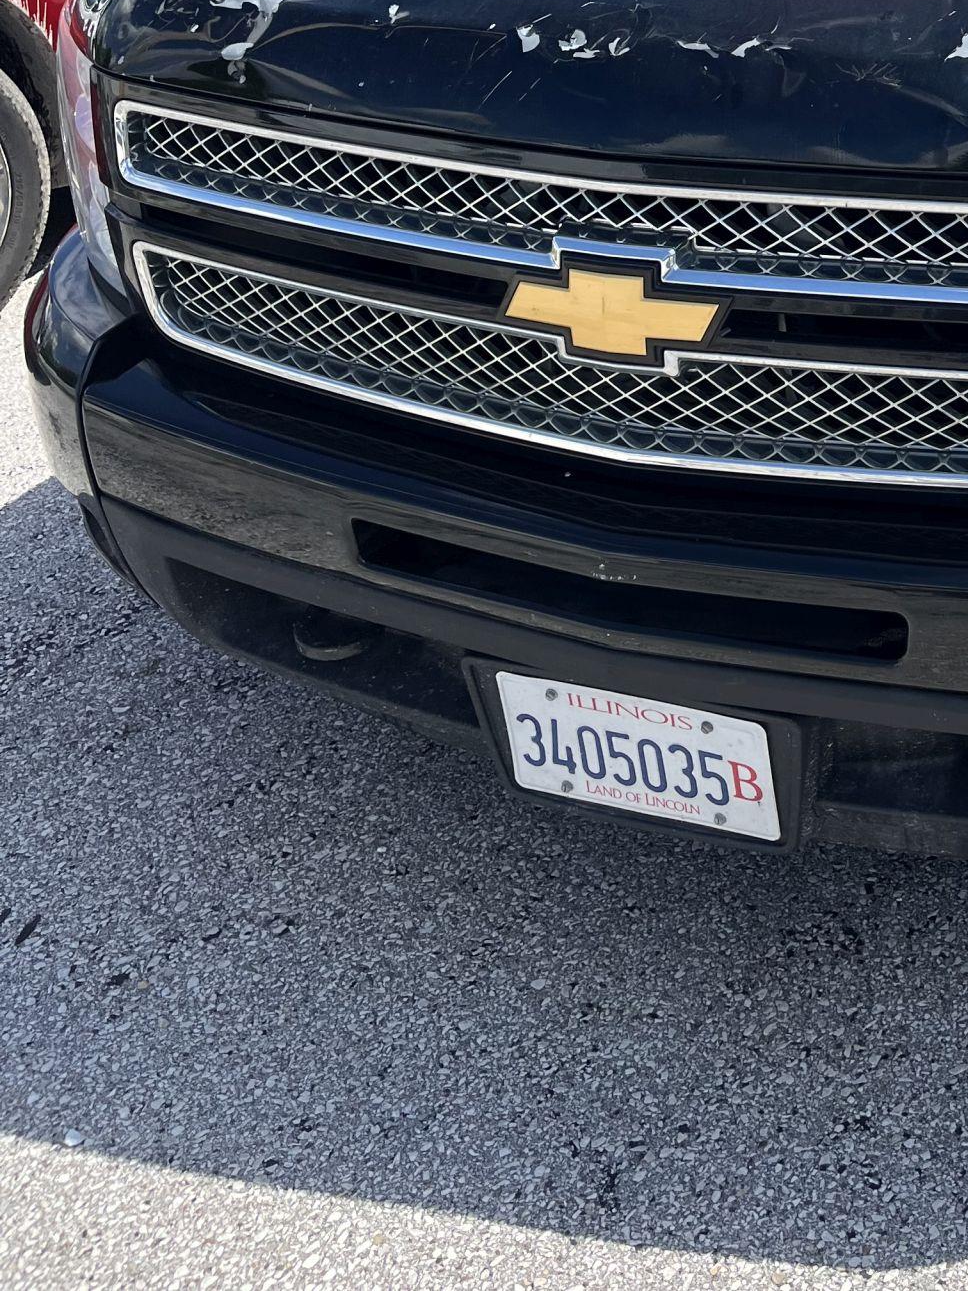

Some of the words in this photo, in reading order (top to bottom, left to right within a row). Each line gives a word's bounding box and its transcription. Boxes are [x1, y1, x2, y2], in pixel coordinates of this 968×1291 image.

[566, 692, 693, 732] ILLINOIS
[585, 780, 622, 801] LAND
[645, 792, 701, 815] LINCOLN
